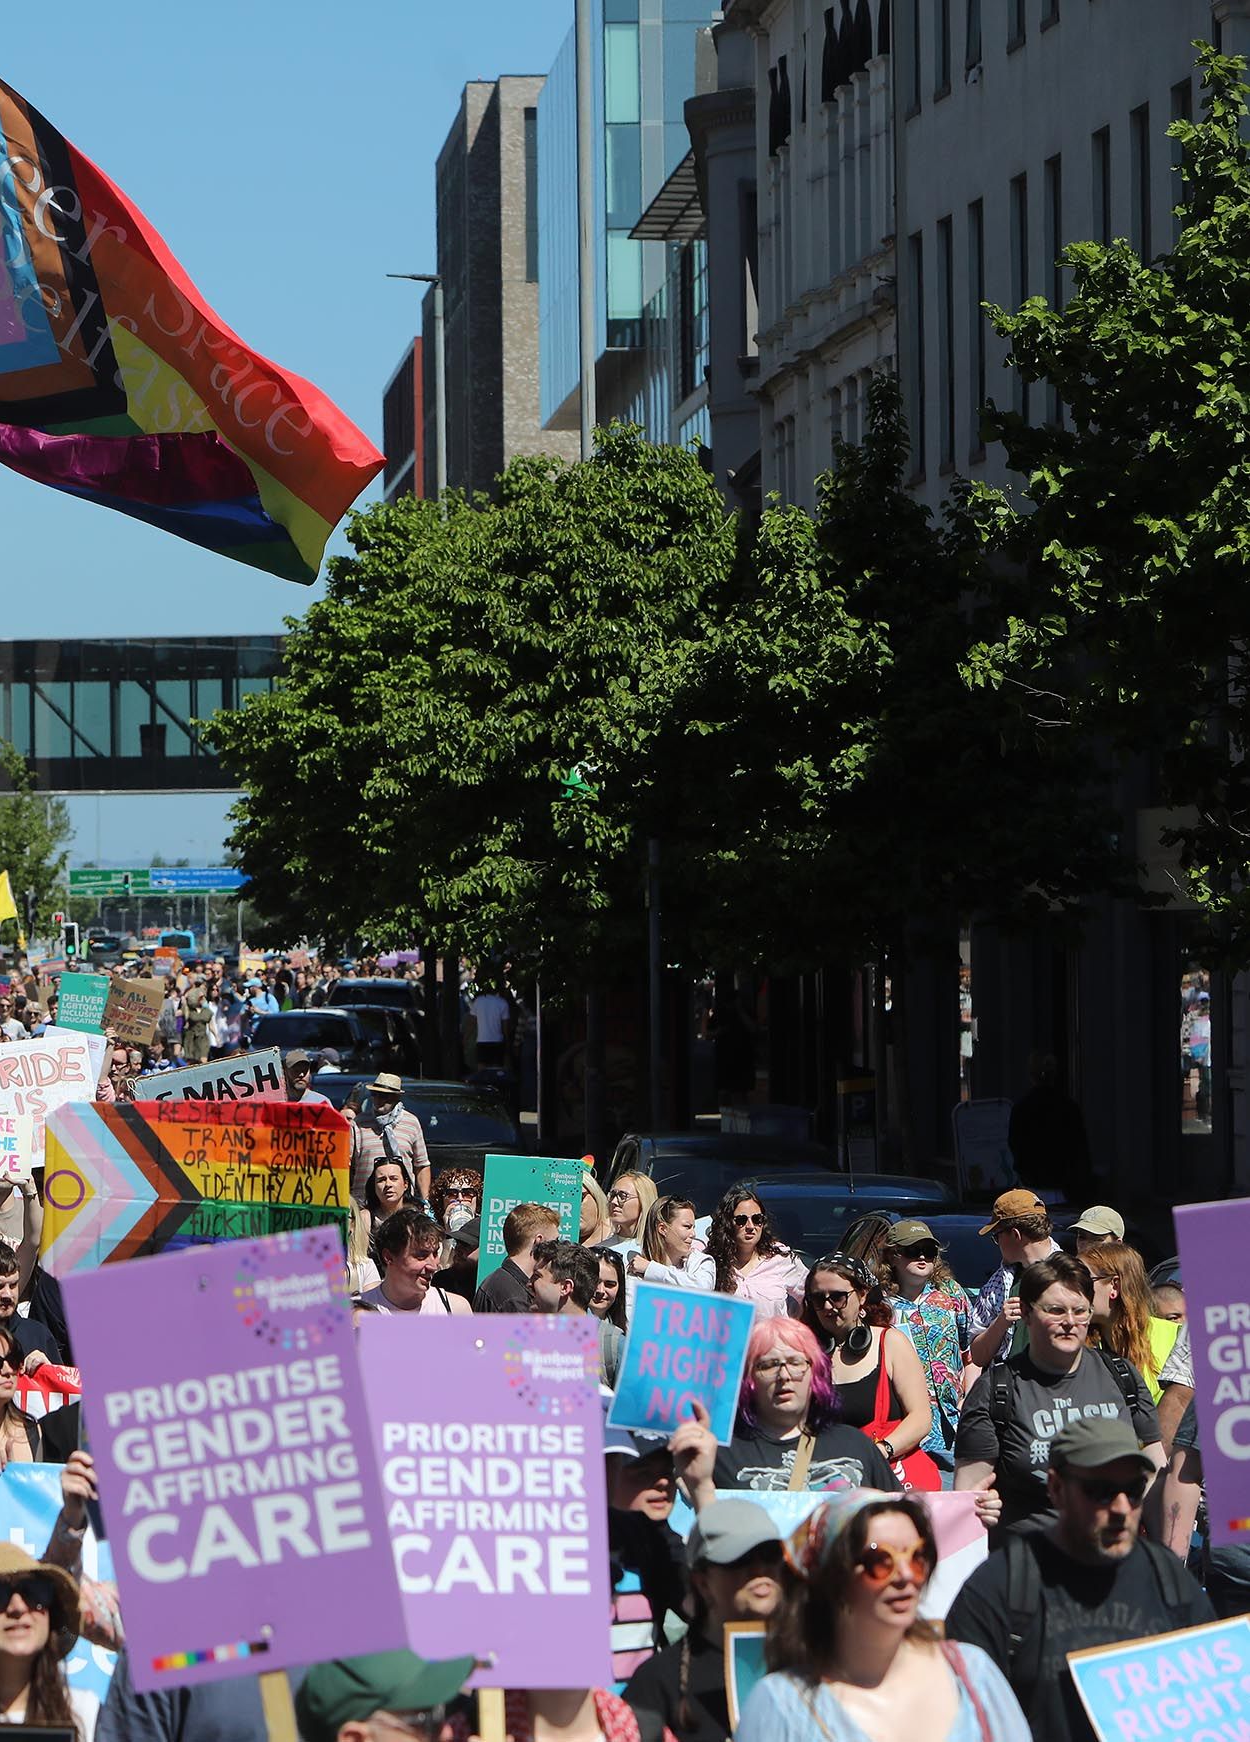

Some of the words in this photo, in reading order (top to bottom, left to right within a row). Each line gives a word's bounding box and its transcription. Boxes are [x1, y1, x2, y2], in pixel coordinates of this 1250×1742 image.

[62, 993, 104, 1005] DELIVER
[14, 1088, 49, 1115] IS
[158, 1101, 263, 1127] RESPECT
[286, 1104, 327, 1129] MY
[182, 1127, 256, 1151] TRANS
[270, 1131, 336, 1155] HOMIES
[183, 1149, 210, 1170] OR
[270, 1152, 335, 1178] GONNA
[201, 1172, 285, 1203] IDENTIFY
[292, 1175, 314, 1205] AS
[326, 1177, 340, 1208] A
[490, 1198, 573, 1217] DEER
[652, 1299, 733, 1345] TRANS
[637, 1341, 729, 1388] RIGHTS
[104, 1354, 343, 1428] PRIORITISE
[1052, 1397, 1072, 1409] The
[111, 1395, 351, 1475] GENDER
[382, 1422, 585, 1455] PRIORITISE
[122, 1442, 359, 1516] AFFIRMING
[382, 1457, 586, 1498] GENDER
[126, 1481, 372, 1584] CARE
[387, 1499, 589, 1532] AFFIRMING
[393, 1535, 592, 1595] CARE
[1098, 1637, 1243, 1702] TRANS
